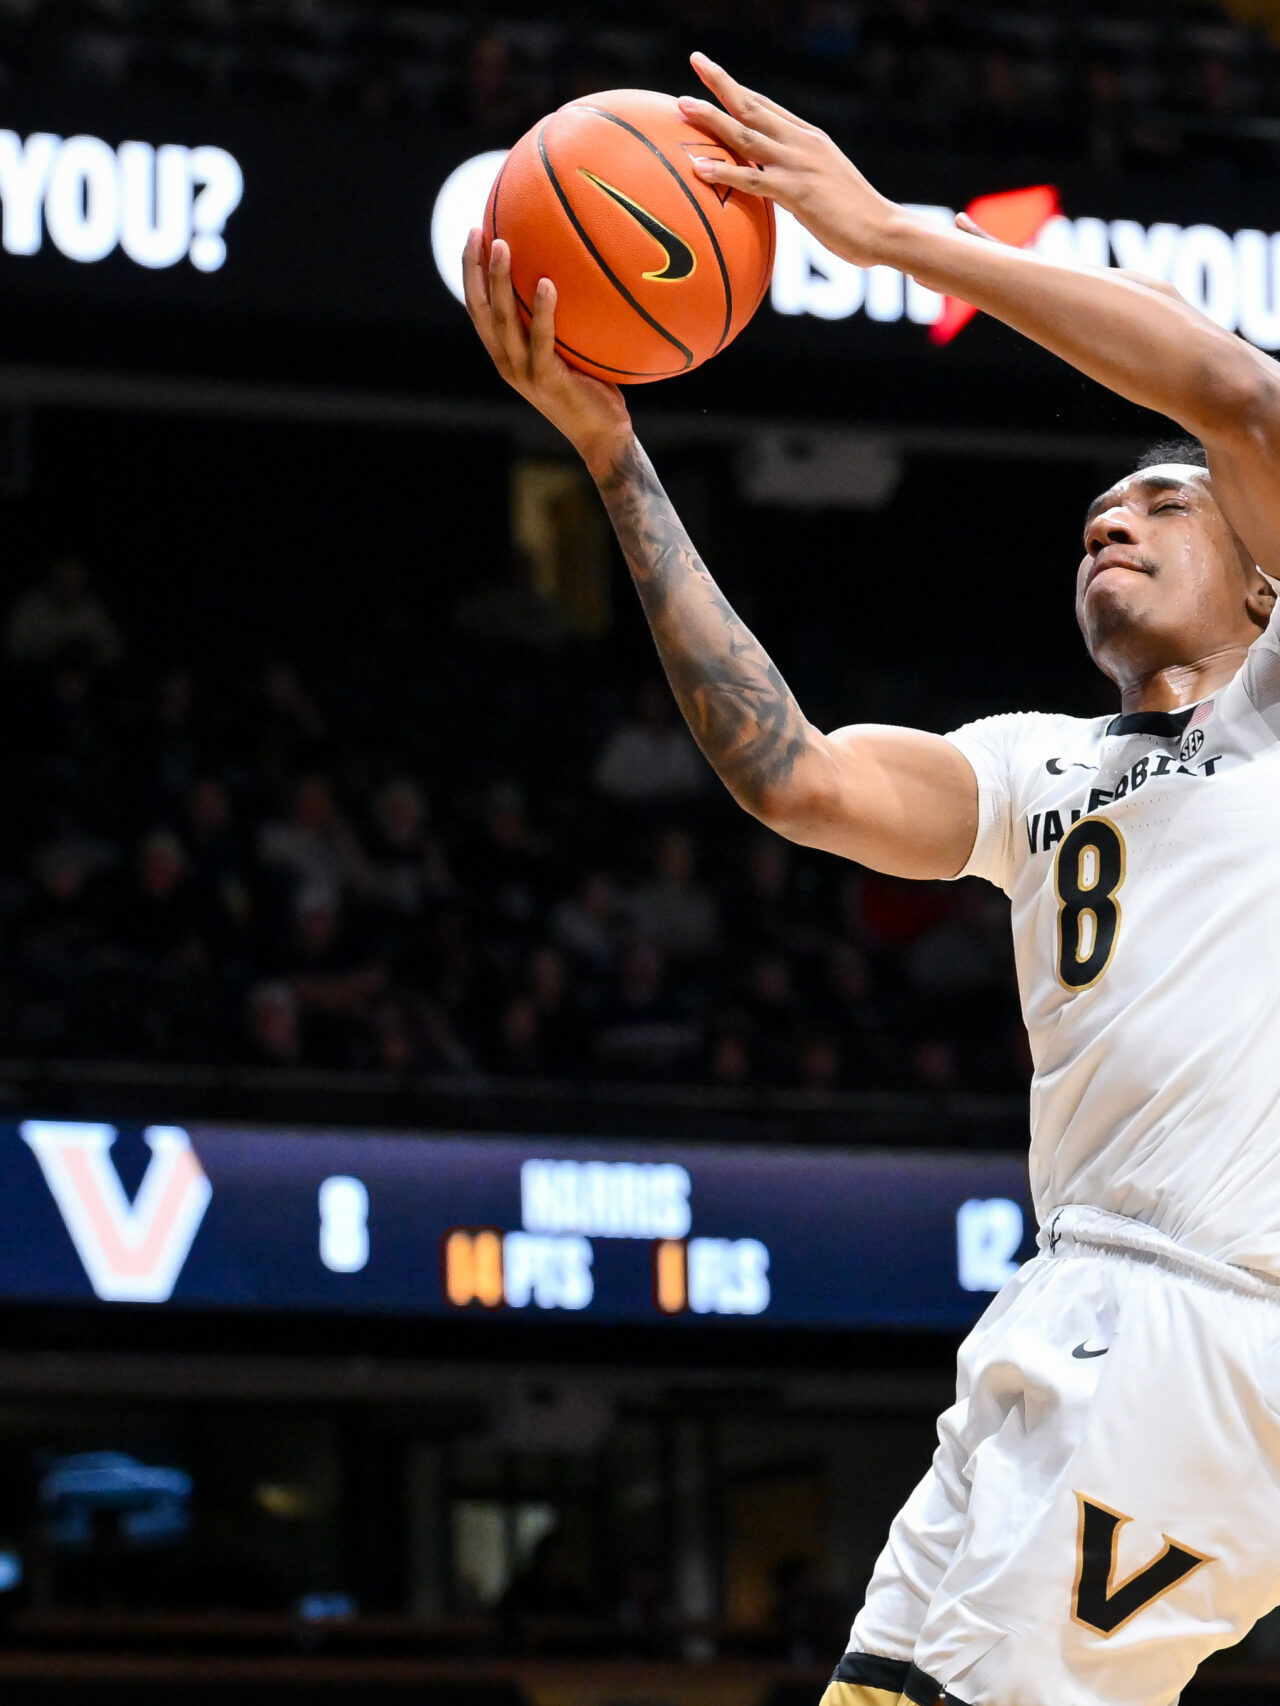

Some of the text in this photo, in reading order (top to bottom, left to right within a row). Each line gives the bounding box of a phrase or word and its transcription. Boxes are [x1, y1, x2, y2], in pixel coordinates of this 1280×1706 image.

[0, 128, 244, 273] YOU?
[1179, 729, 1205, 762] SEC
[1054, 815, 1127, 993] 8
[18, 1119, 213, 1303] V
[1071, 1490, 1218, 1639] V
